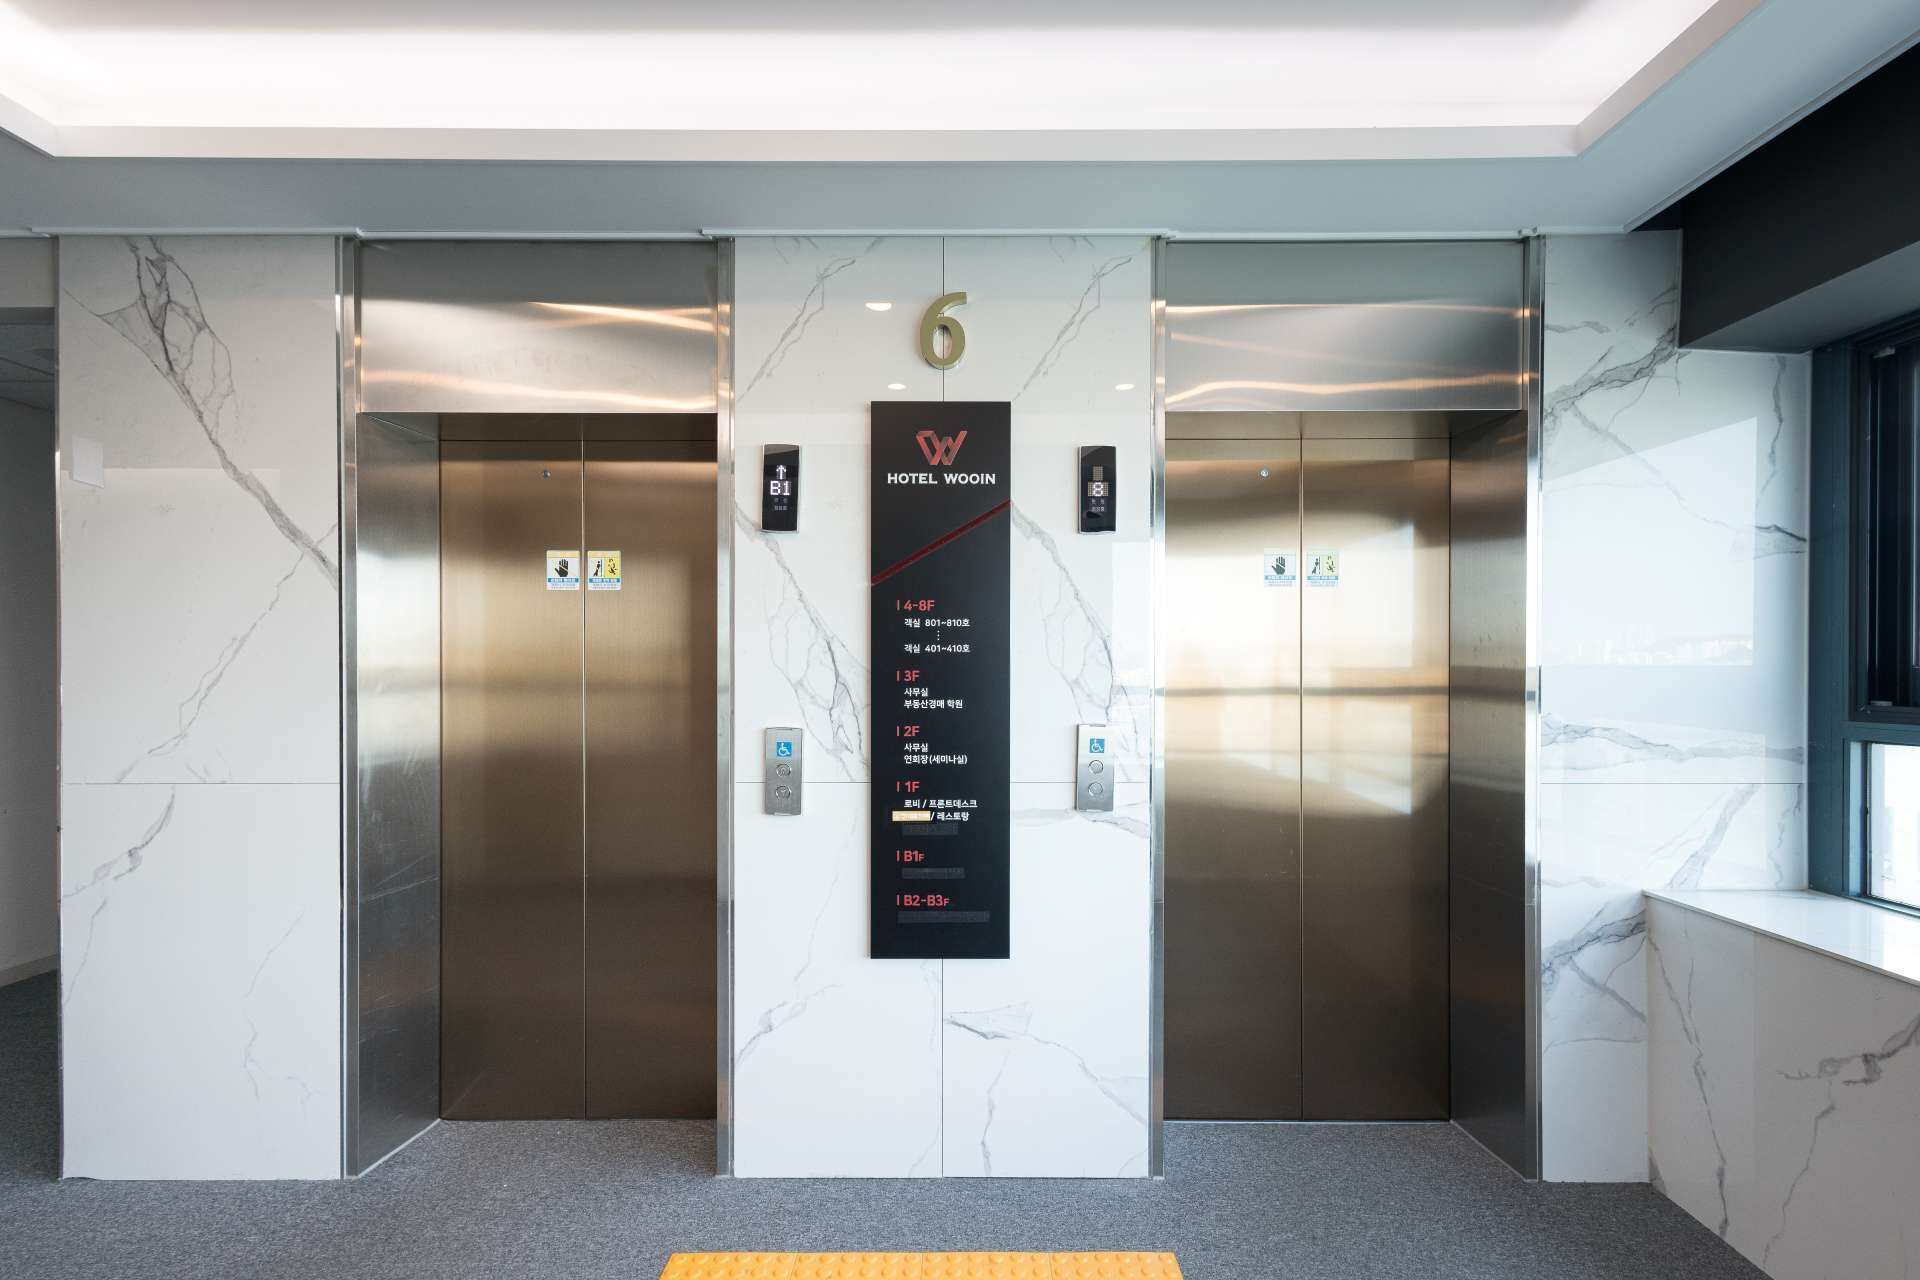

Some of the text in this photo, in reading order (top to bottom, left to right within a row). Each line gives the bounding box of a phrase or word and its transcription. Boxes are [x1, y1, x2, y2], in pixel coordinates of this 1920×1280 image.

[920, 292, 967, 370] 6
[887, 473, 996, 485] HOTEL WOOIN
[770, 481, 790, 496] B1
[1093, 481, 1104, 497] 8
[903, 600, 935, 611] 4-8F
[904, 618, 970, 628] 객실 801~810호
[904, 644, 971, 653] 객실 401~410호
[904, 670, 920, 681] 3F
[904, 687, 928, 697] 사무실
[904, 699, 963, 709] 부동산경매 학원
[904, 725, 920, 737] 2F
[904, 743, 928, 752] 사무실
[904, 781, 920, 792] 1F
[904, 799, 920, 808] 로비
[929, 799, 978, 808] 프론트데스크
[936, 811, 970, 821] 레스토랑
[903, 850, 925, 862] B1F
[903, 894, 950, 906] B2-B3F
